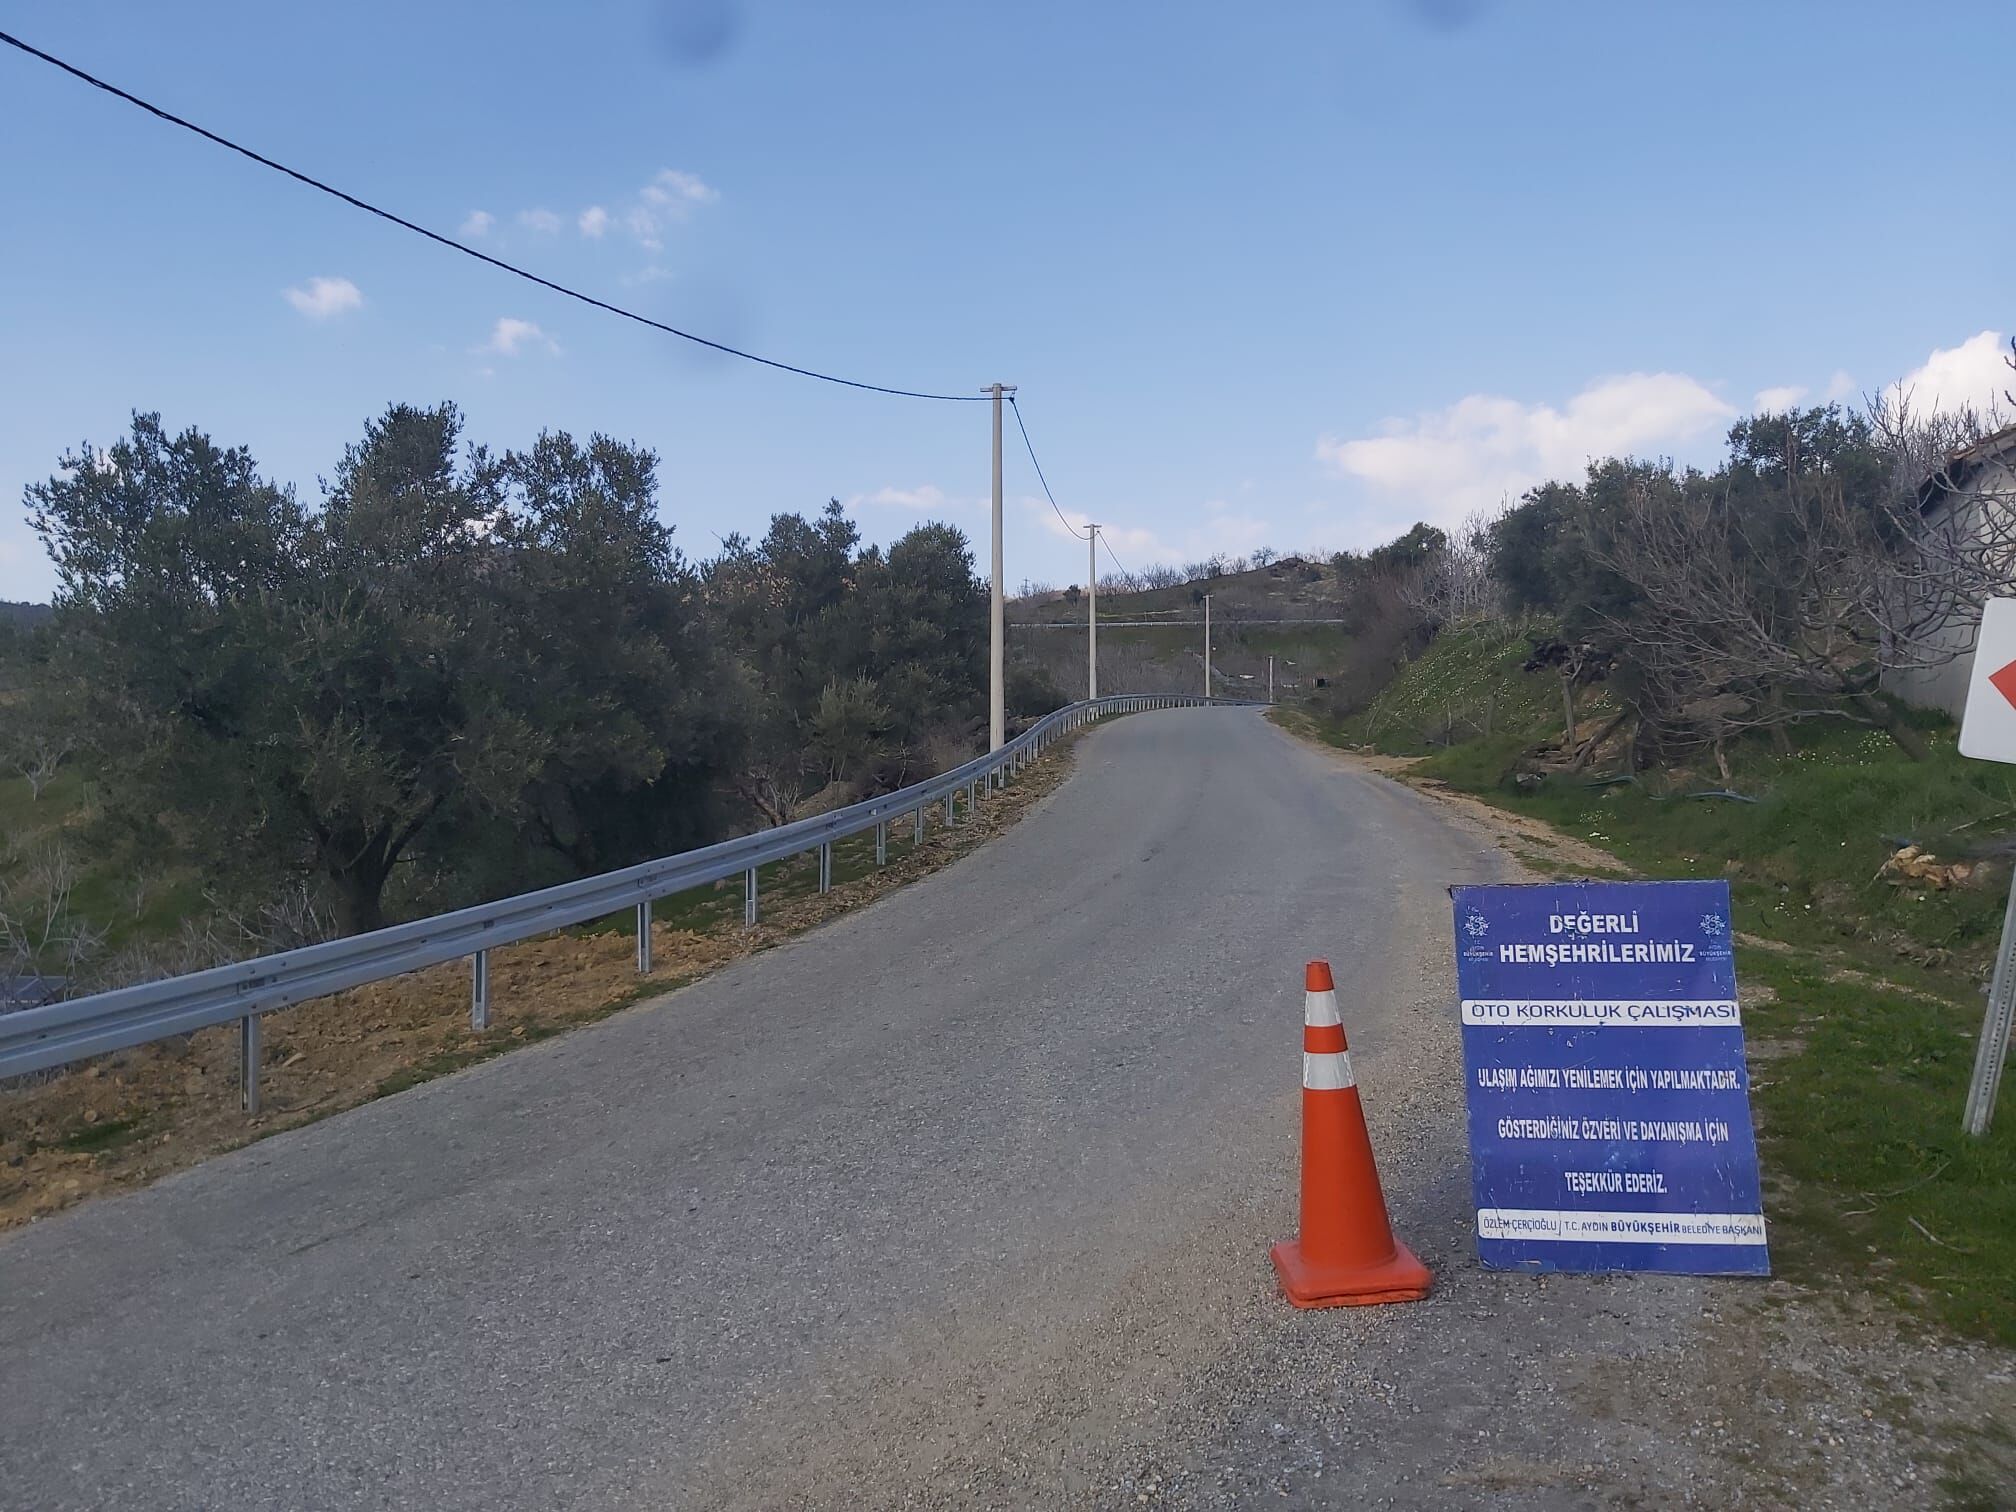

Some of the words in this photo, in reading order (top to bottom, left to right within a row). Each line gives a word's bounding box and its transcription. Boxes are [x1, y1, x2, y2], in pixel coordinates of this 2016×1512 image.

[1550, 911, 1639, 933] DEĞERLİ
[1500, 940, 1695, 967] HEMŞEHRİLERİMİZ
[1472, 1004, 1510, 1018] OTO
[1517, 1004, 1622, 1018] KORKULUK
[1627, 1004, 1736, 1022] ÇALIŞMASI
[1478, 1068, 1517, 1092] ULAŞIM
[1520, 1065, 1560, 1088] AĞIMIZI
[1562, 1065, 1624, 1089] YENİLEMEK
[1625, 1066, 1648, 1094] İÇİN
[1498, 1115, 1579, 1139] GÖSTERDİĞİNİZ
[1582, 1116, 1620, 1140] ÖZVERİ
[1623, 1121, 1638, 1140] VE
[1640, 1121, 1703, 1145] DAYANIŞMA
[1704, 1118, 1729, 1146] İÇİN
[1565, 1169, 1623, 1196] TEŞEKKÜR
[1625, 1169, 1667, 1193] EDERİZ.
[1484, 1217, 1510, 1228] ÖZLEM
[1512, 1218, 1557, 1231] ÇERÇİOĞLU
[1565, 1221, 1579, 1230] T.C.
[1581, 1222, 1608, 1231] AYDIN
[1611, 1220, 1680, 1235] BÜYÜKŞEHİR
[1682, 1223, 1720, 1234] BELEDİYE
[1722, 1225, 1762, 1236] BAŞKANI
